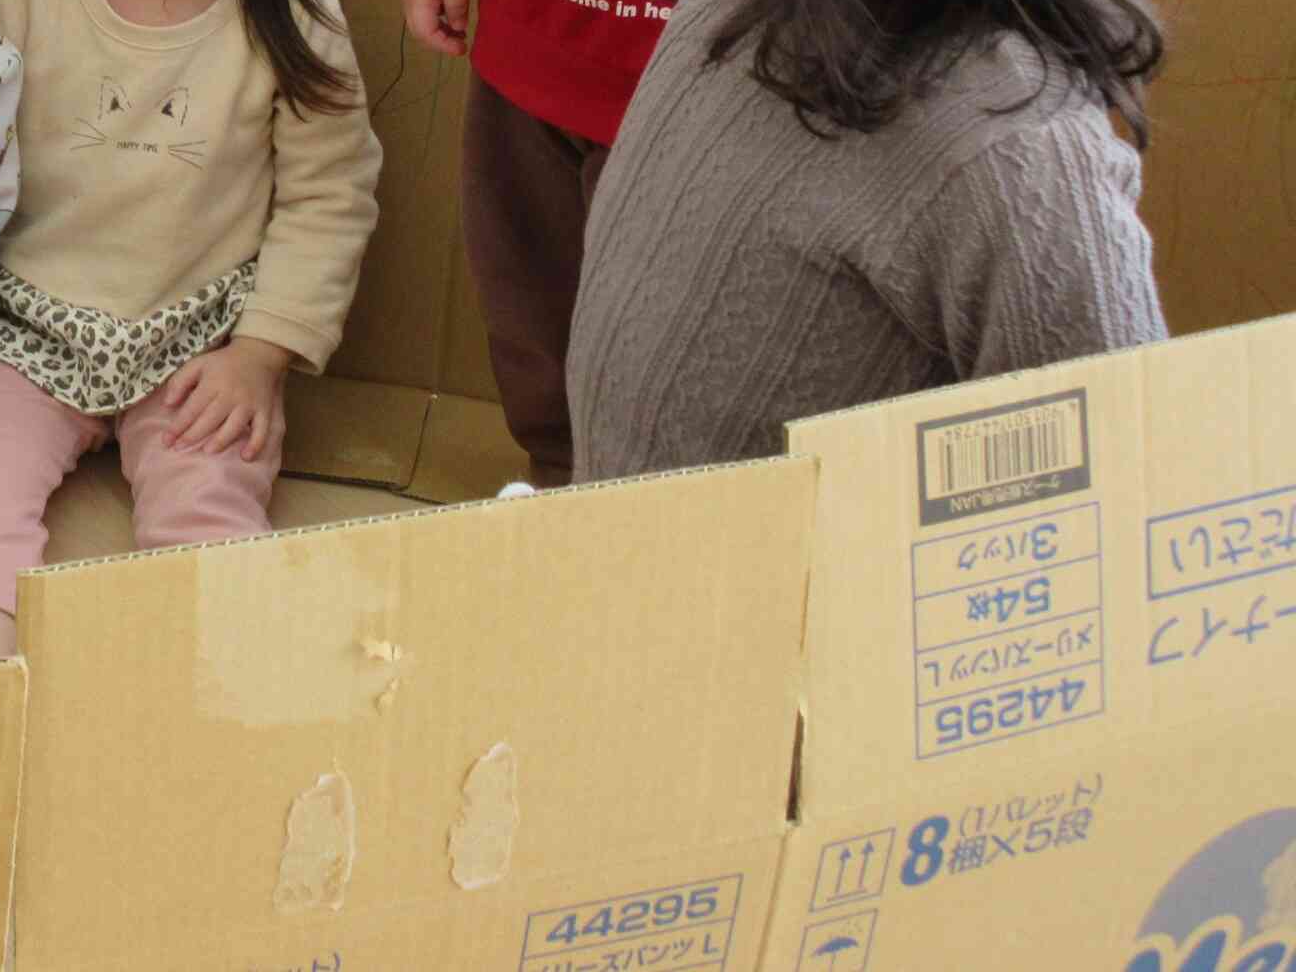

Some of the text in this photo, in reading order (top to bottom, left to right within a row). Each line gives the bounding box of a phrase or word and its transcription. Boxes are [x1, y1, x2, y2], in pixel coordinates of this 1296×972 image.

[615, 0, 637, 18] in
[966, 576, 1051, 623] 54枚
[923, 622, 1094, 688] メリーズパンツ L
[935, 677, 1087, 745] 44295
[545, 885, 719, 945] 44295
